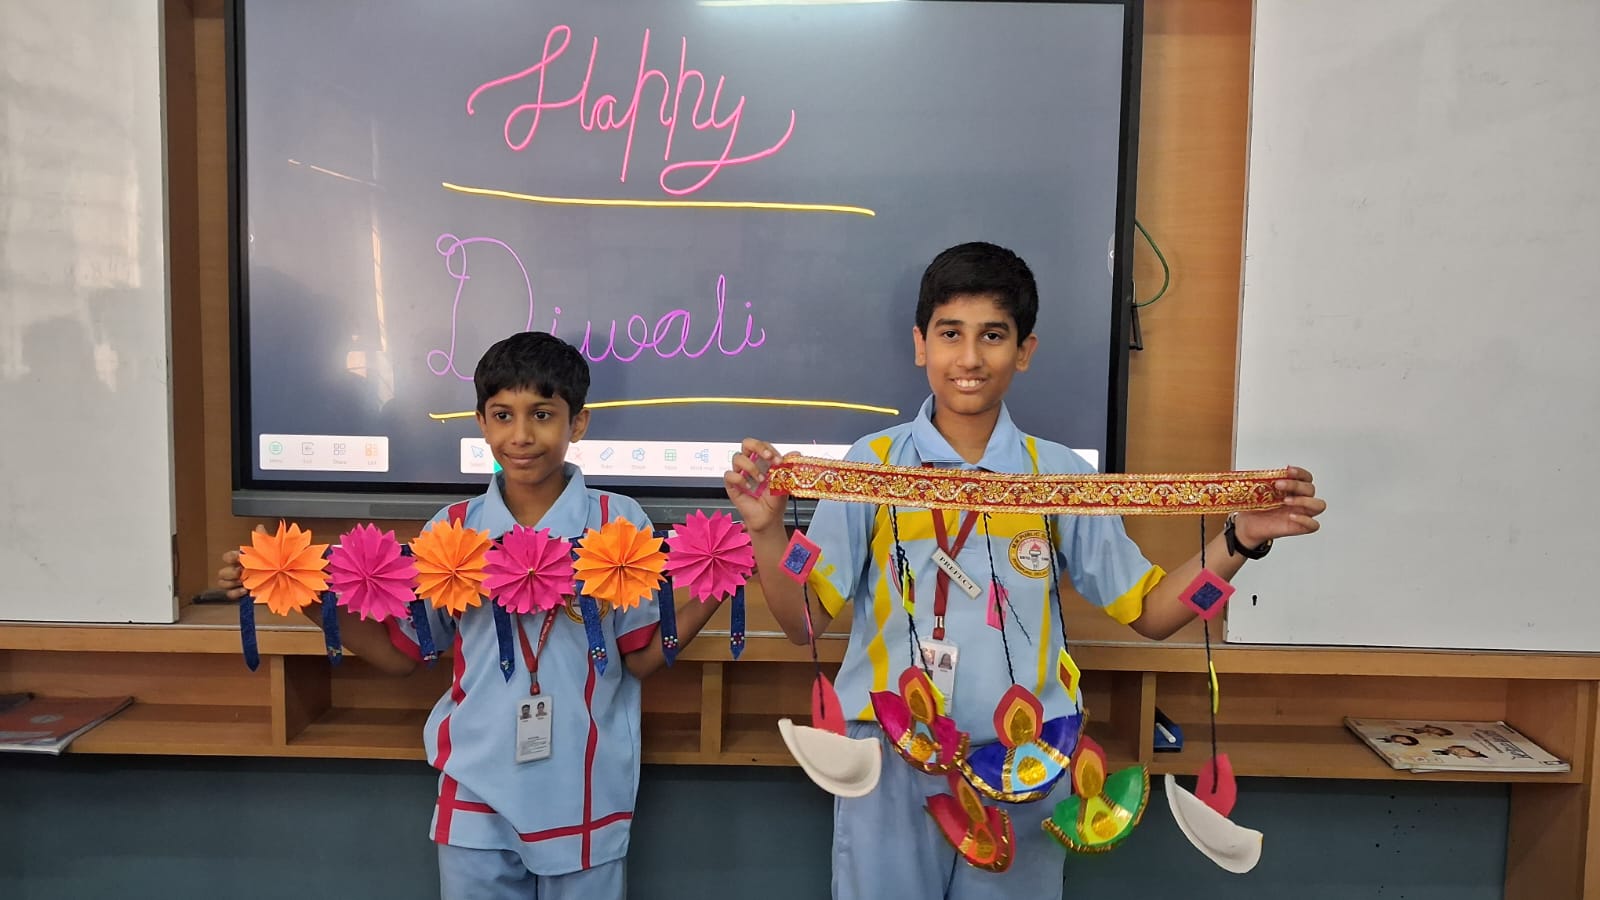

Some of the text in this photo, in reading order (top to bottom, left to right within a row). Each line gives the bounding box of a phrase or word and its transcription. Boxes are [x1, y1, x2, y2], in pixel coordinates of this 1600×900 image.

[466, 25, 796, 195] Happy
[427, 233, 766, 381] Diwali
[939, 556, 974, 591] PREFECT
